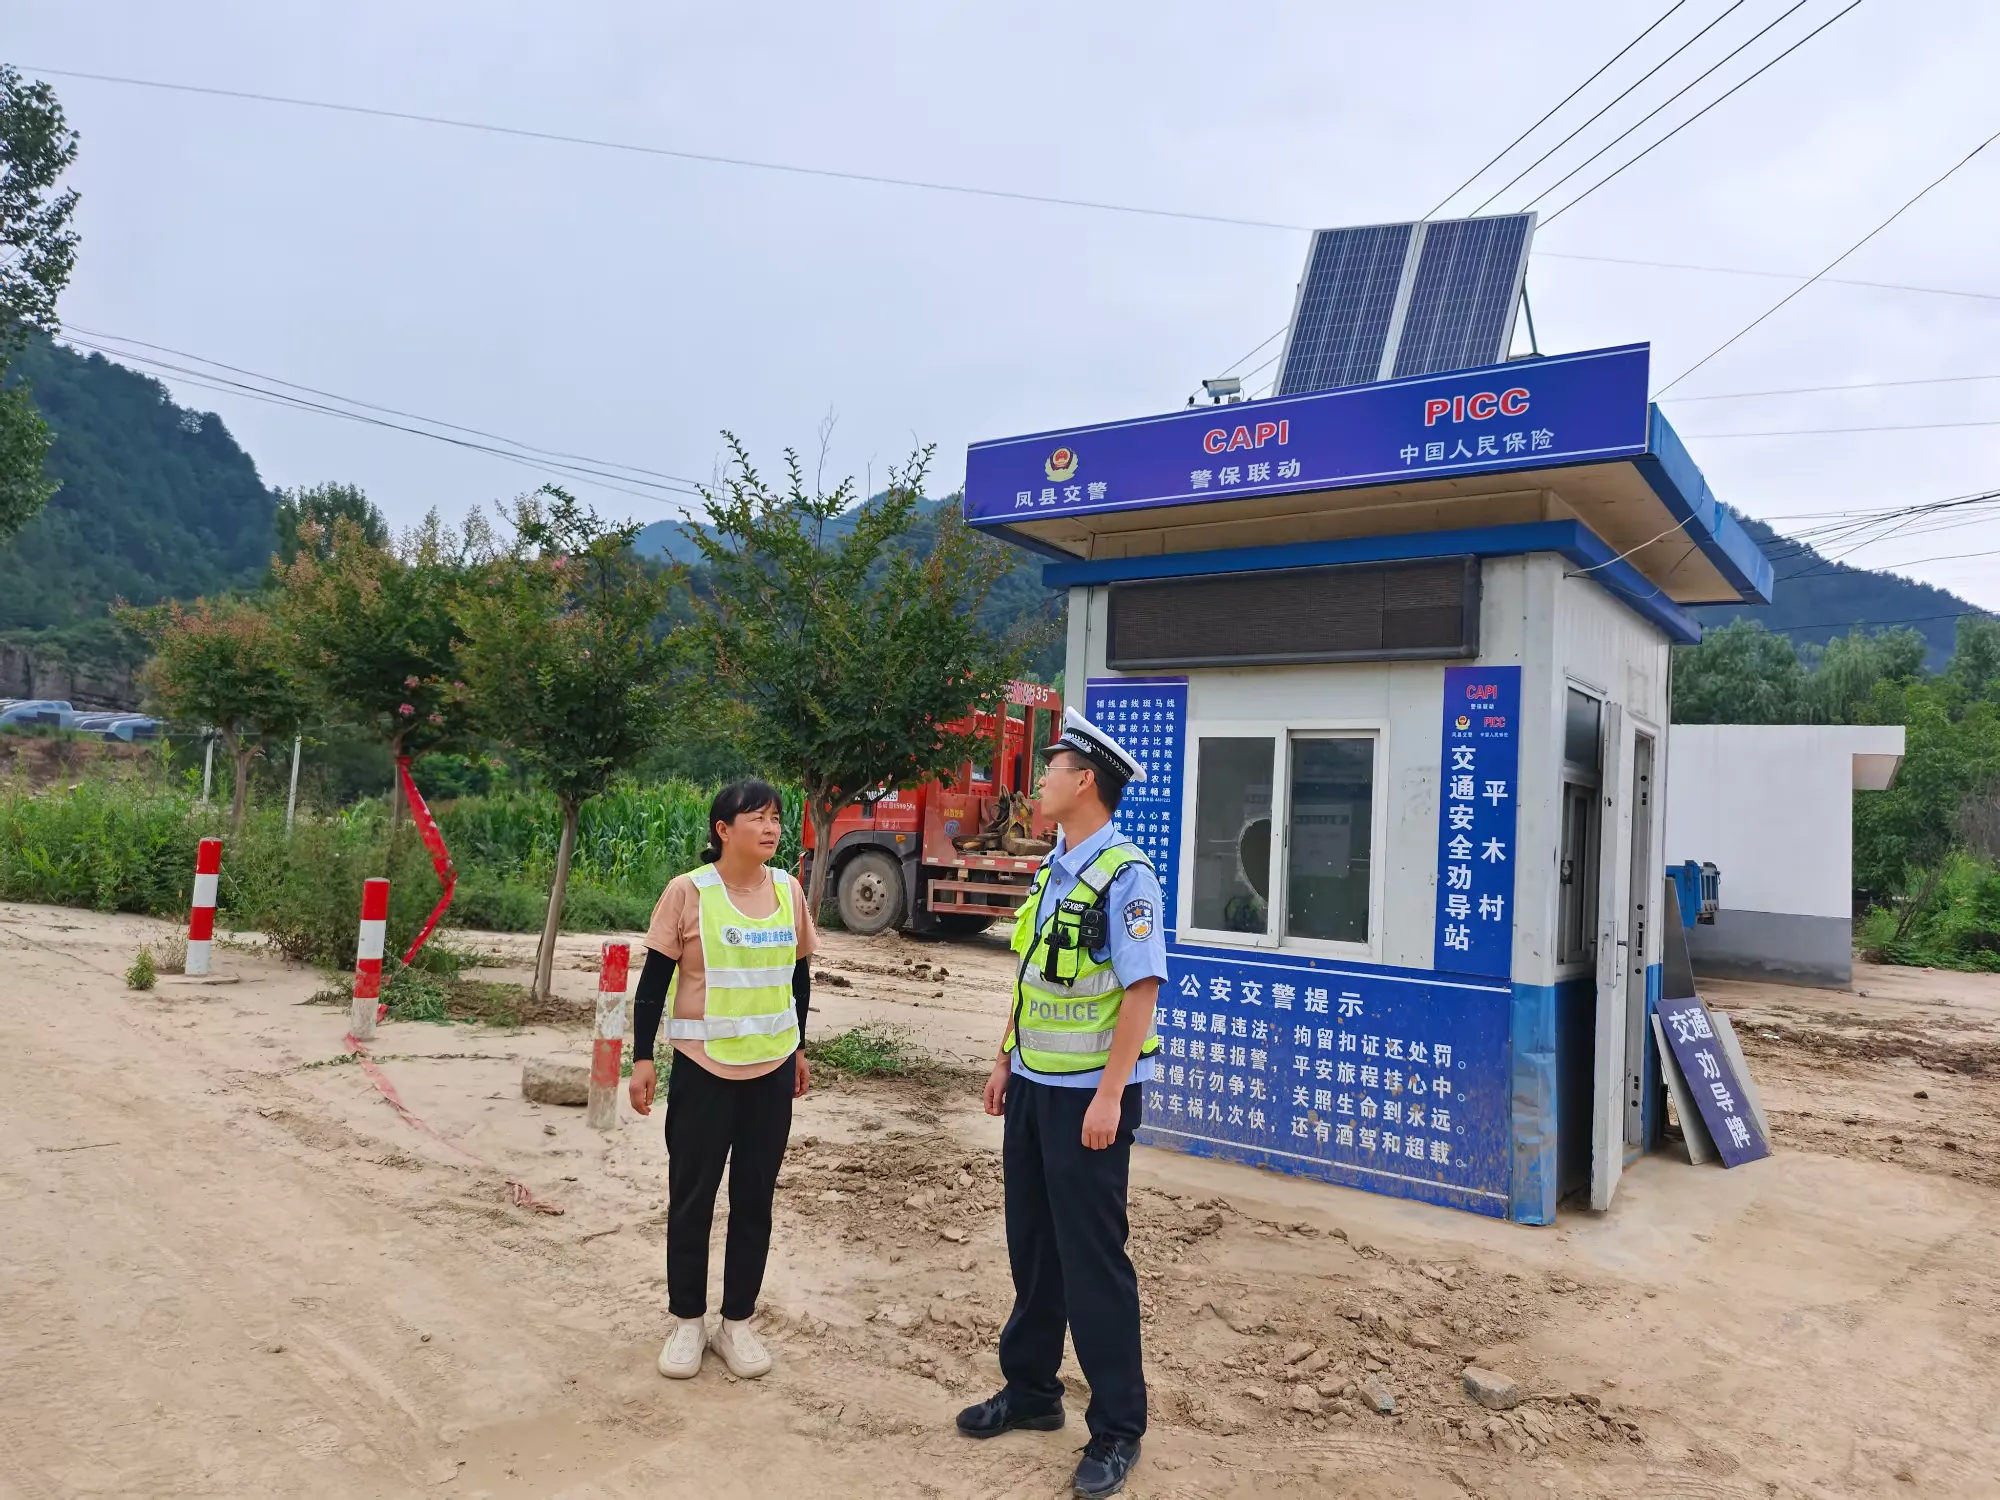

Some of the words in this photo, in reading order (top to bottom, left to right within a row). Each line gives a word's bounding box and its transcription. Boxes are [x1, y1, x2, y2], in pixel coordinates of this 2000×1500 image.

[1424, 387, 1531, 427] PICC
[1203, 419, 1290, 455] CAPI
[1399, 429, 1556, 466] 中国人民保险
[1190, 460, 1302, 490] 警保联动
[1013, 480, 1108, 509] 凤县交警
[1466, 684, 1498, 700] CAPI
[1096, 712, 1175, 721] 都是生命安全线
[1483, 716, 1506, 728] PICC
[1112, 736, 1174, 746] 死神去比赛
[1444, 745, 1477, 951] 交通安全劝导站
[1478, 780, 1509, 922] 平木村
[1029, 999, 1100, 1021] POLICE
[1179, 973, 1365, 1018] 公安交警提示
[1142, 1091, 1464, 1168] 次车祸九次快，还有酒驾和超载。
